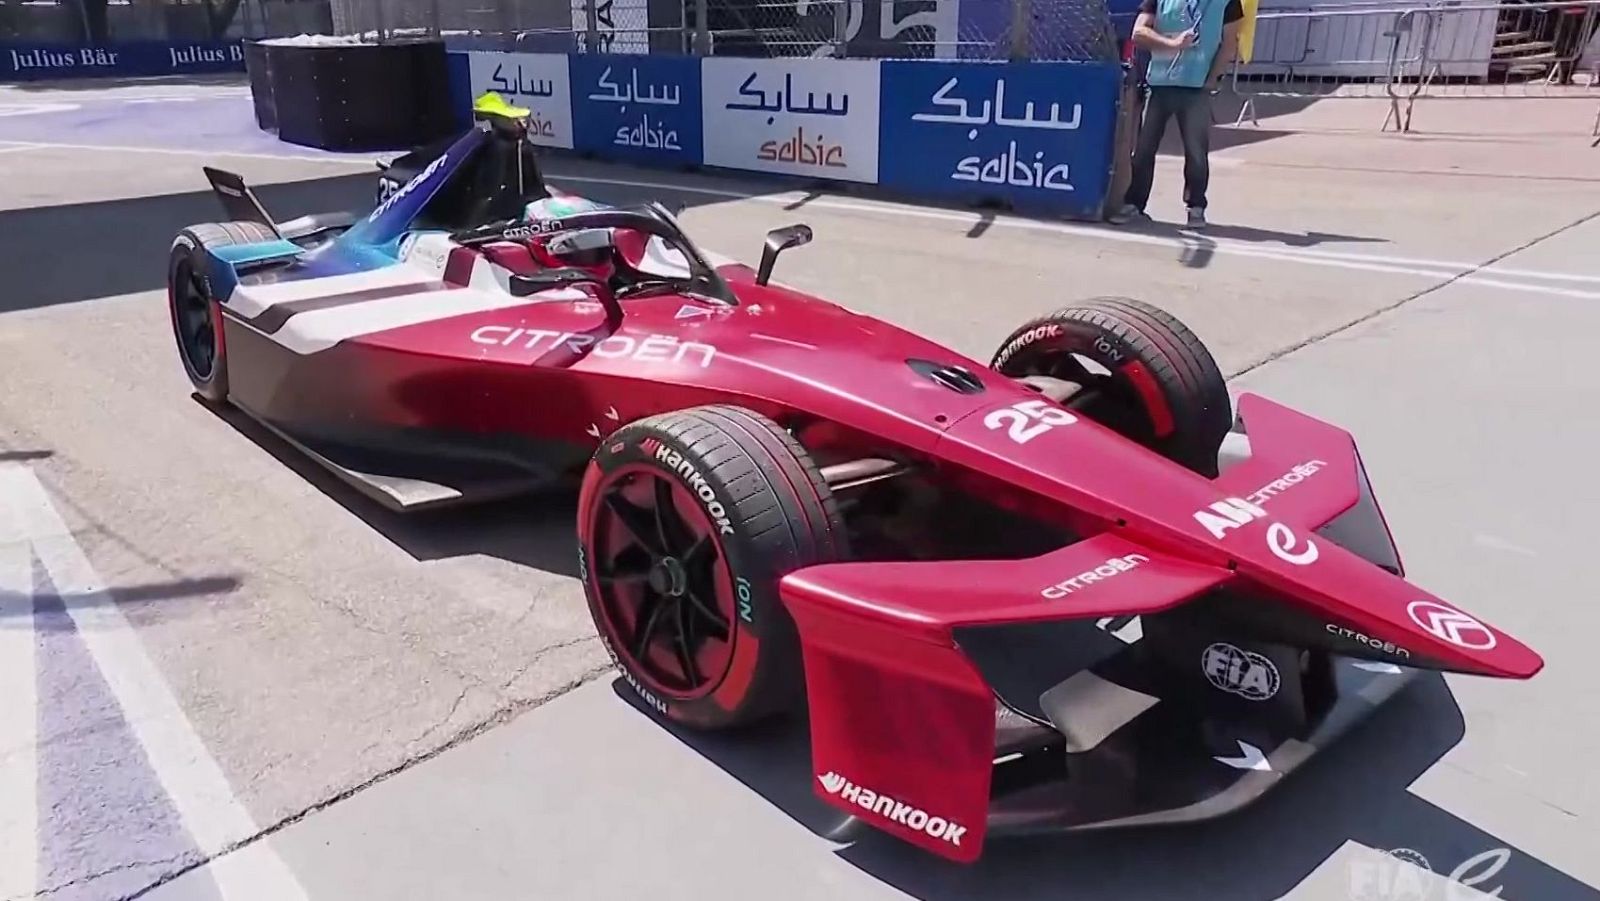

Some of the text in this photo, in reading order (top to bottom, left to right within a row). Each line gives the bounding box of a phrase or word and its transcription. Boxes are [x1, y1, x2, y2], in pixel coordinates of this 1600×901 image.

[10, 48, 118, 71] Julius Bär
[169, 46, 225, 67] Julius
[725, 71, 848, 125] سابك
[911, 77, 1082, 140] سابك
[613, 113, 682, 151] sabic
[757, 126, 847, 168] sabic
[951, 140, 1074, 191] sabic
[983, 400, 1078, 444] 25
[737, 577, 752, 622] ION
